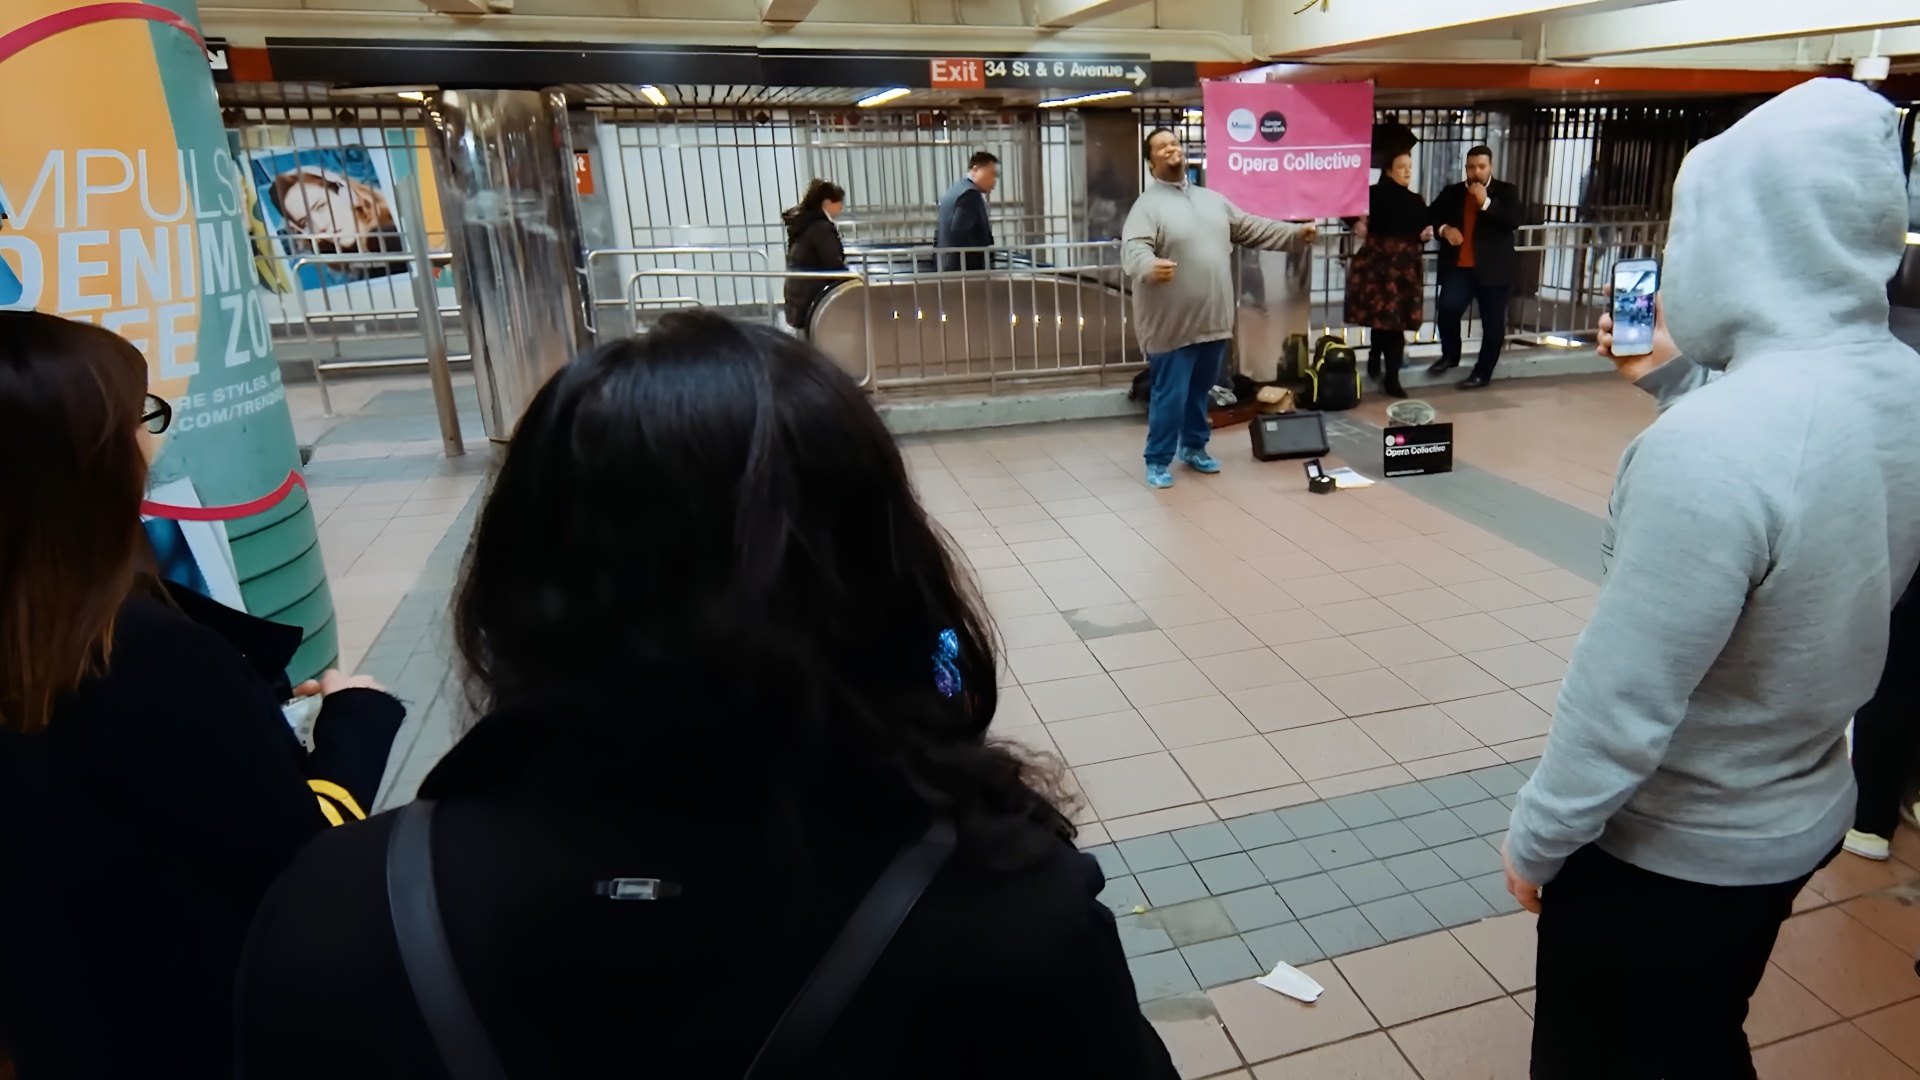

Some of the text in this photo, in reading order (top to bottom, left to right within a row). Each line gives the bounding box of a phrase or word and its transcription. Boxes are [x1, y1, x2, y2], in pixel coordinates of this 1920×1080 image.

[931, 59, 1124, 82] Exit 34 St & 6 Avenue
[1228, 151, 1361, 175] Opera Collective
